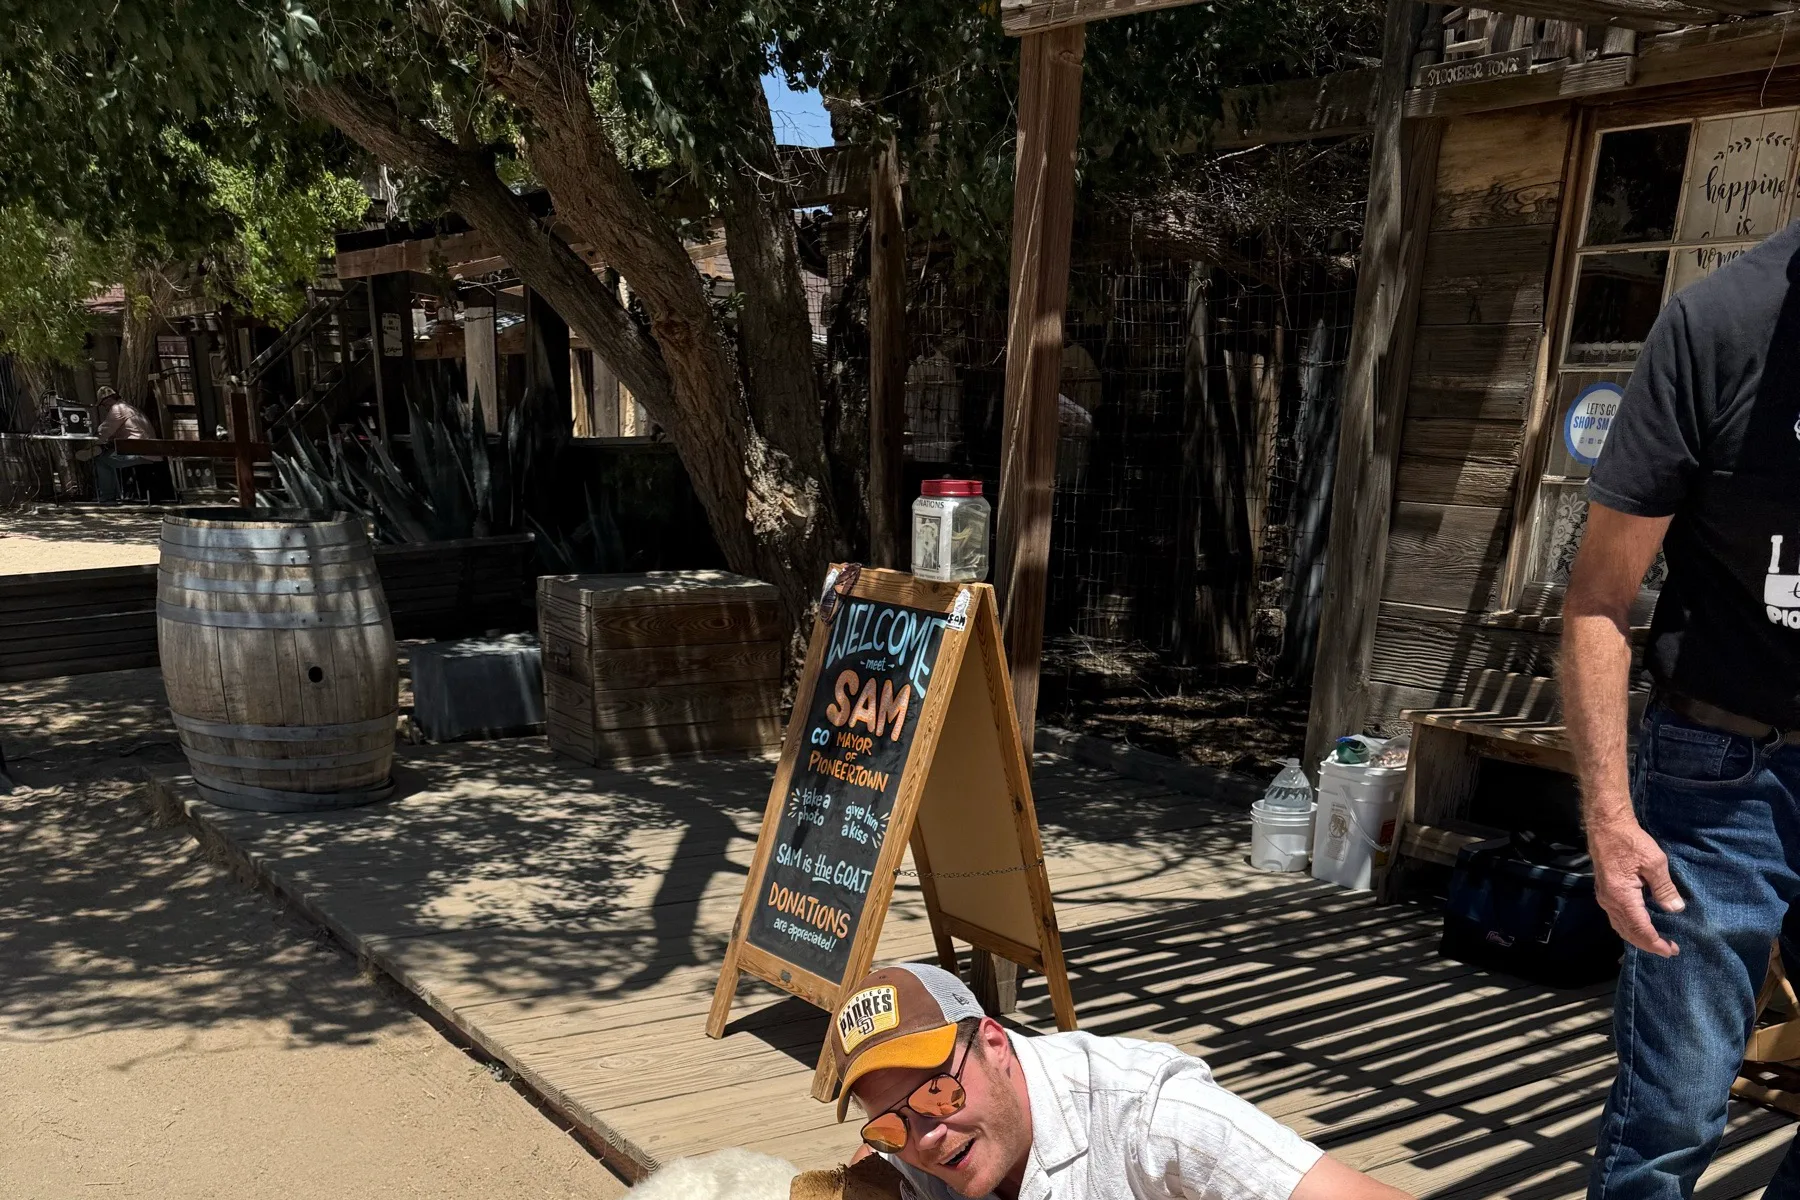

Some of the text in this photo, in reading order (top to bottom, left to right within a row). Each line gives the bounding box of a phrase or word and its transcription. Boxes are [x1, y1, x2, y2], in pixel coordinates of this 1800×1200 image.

[1427, 57, 1520, 87] PIONEER TOWN
[1736, 215, 1756, 236] is
[1573, 416, 1595, 430] SHOP
[1586, 402, 1606, 415] LET'S
[916, 499, 945, 509] NATIONS
[826, 603, 946, 699] WELCOME
[865, 657, 887, 672] meet
[826, 669, 911, 742] SAM
[811, 727, 873, 756] CO MAYOR
[807, 749, 890, 793] PIONEERTOWN
[845, 751, 858, 763] OF
[802, 787, 831, 809] take a
[797, 805, 825, 827] photo
[844, 801, 879, 832] give him
[841, 821, 869, 845] a kiss
[776, 842, 802, 868] SAM
[802, 854, 813, 873] is
[814, 854, 833, 880] the
[768, 881, 851, 939] DONATIONS
[773, 917, 837, 953] are appreciated!
[839, 993, 893, 1038] PADRES
